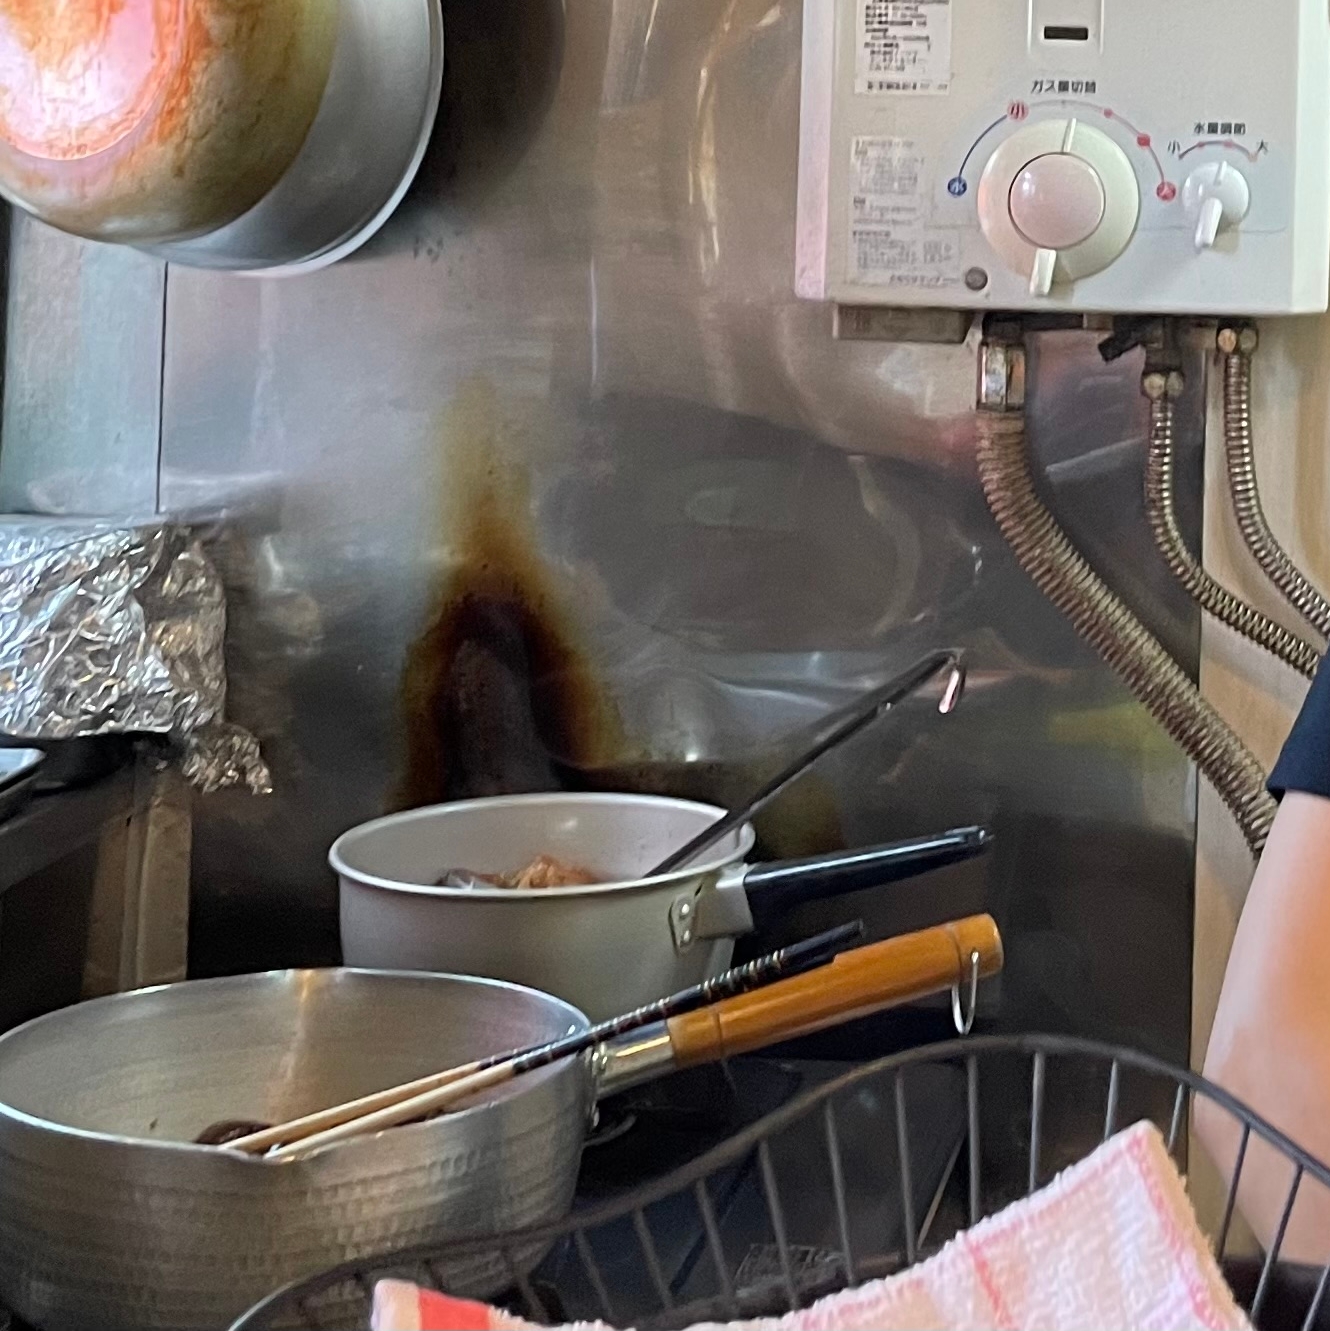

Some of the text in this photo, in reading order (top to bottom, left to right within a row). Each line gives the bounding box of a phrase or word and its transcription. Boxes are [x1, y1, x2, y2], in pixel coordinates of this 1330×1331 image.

[1031, 79, 1097, 94] ガス量切替
[1194, 122, 1245, 136] 水量調節
[1168, 139, 1181, 154] 小
[1257, 139, 1269, 154] 大
